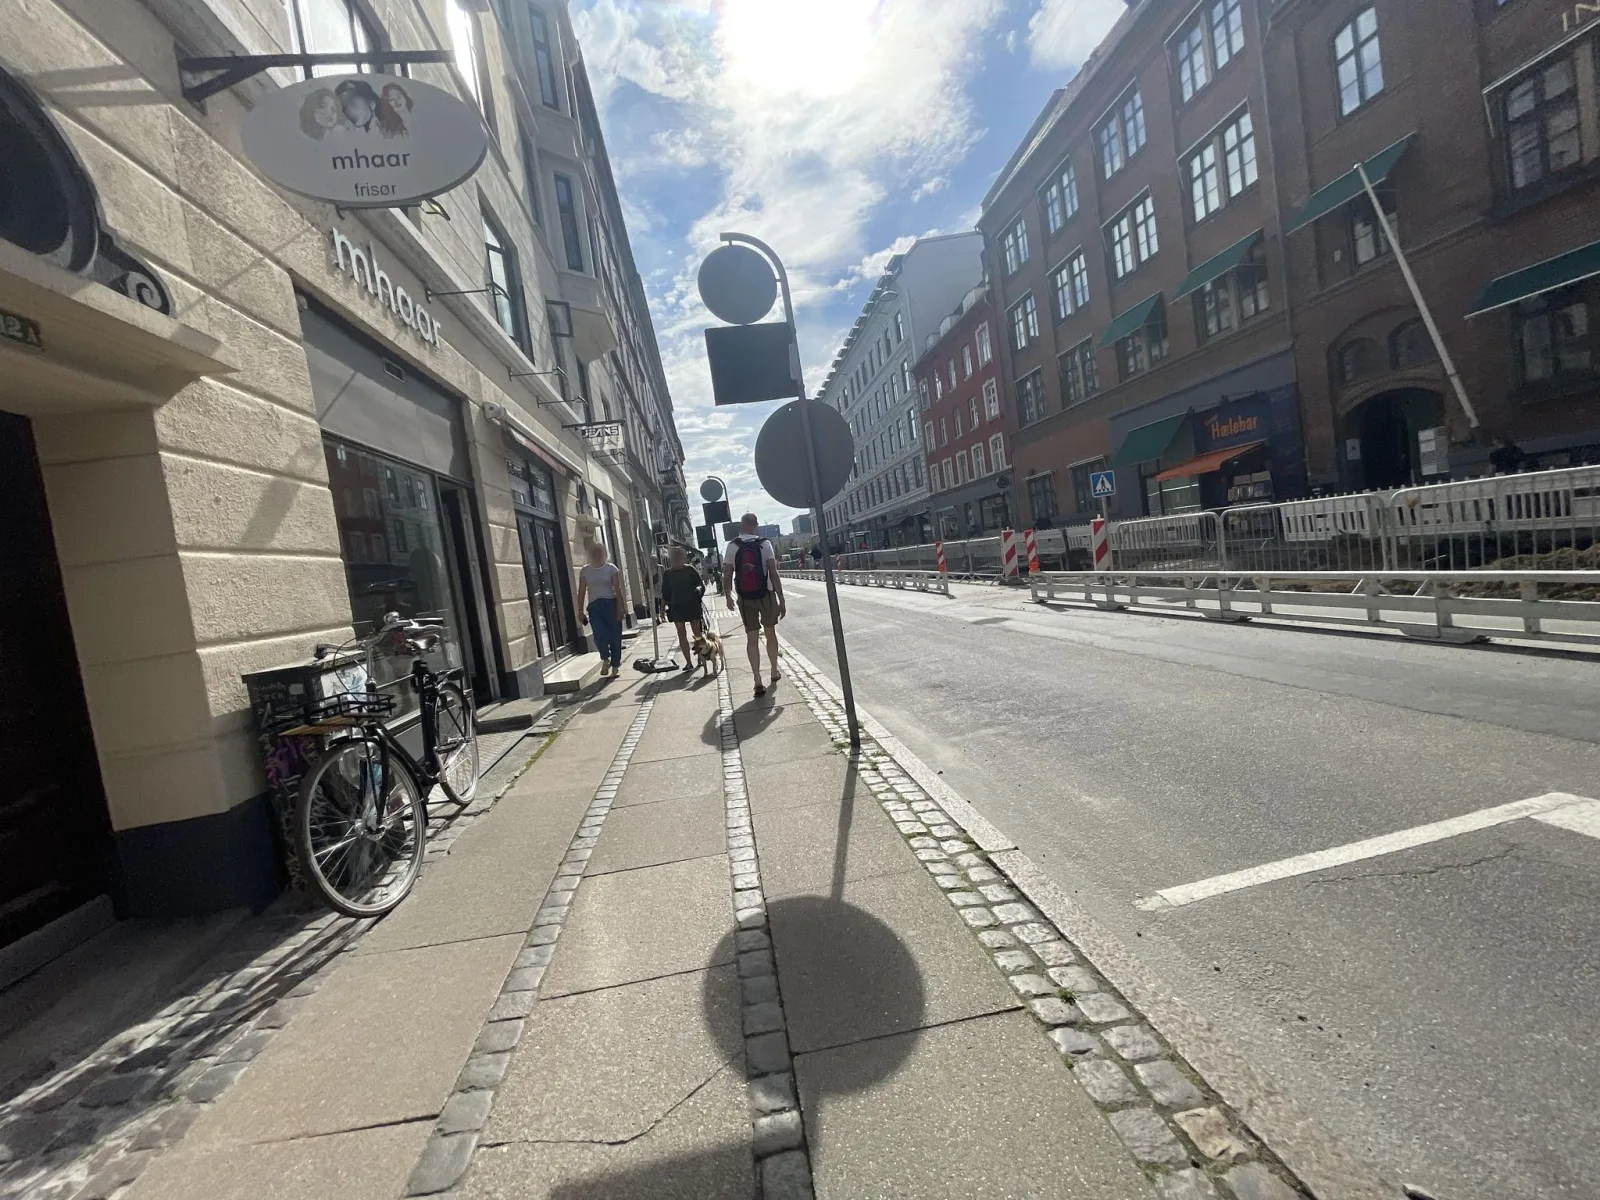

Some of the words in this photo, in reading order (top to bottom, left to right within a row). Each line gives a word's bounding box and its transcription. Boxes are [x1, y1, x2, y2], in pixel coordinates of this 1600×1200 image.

[332, 147, 411, 169] mhaar
[354, 182, 396, 197] frisør
[332, 226, 441, 349] mhaar
[582, 426, 619, 438] JEANS
[1211, 415, 1258, 440] Hælebar
